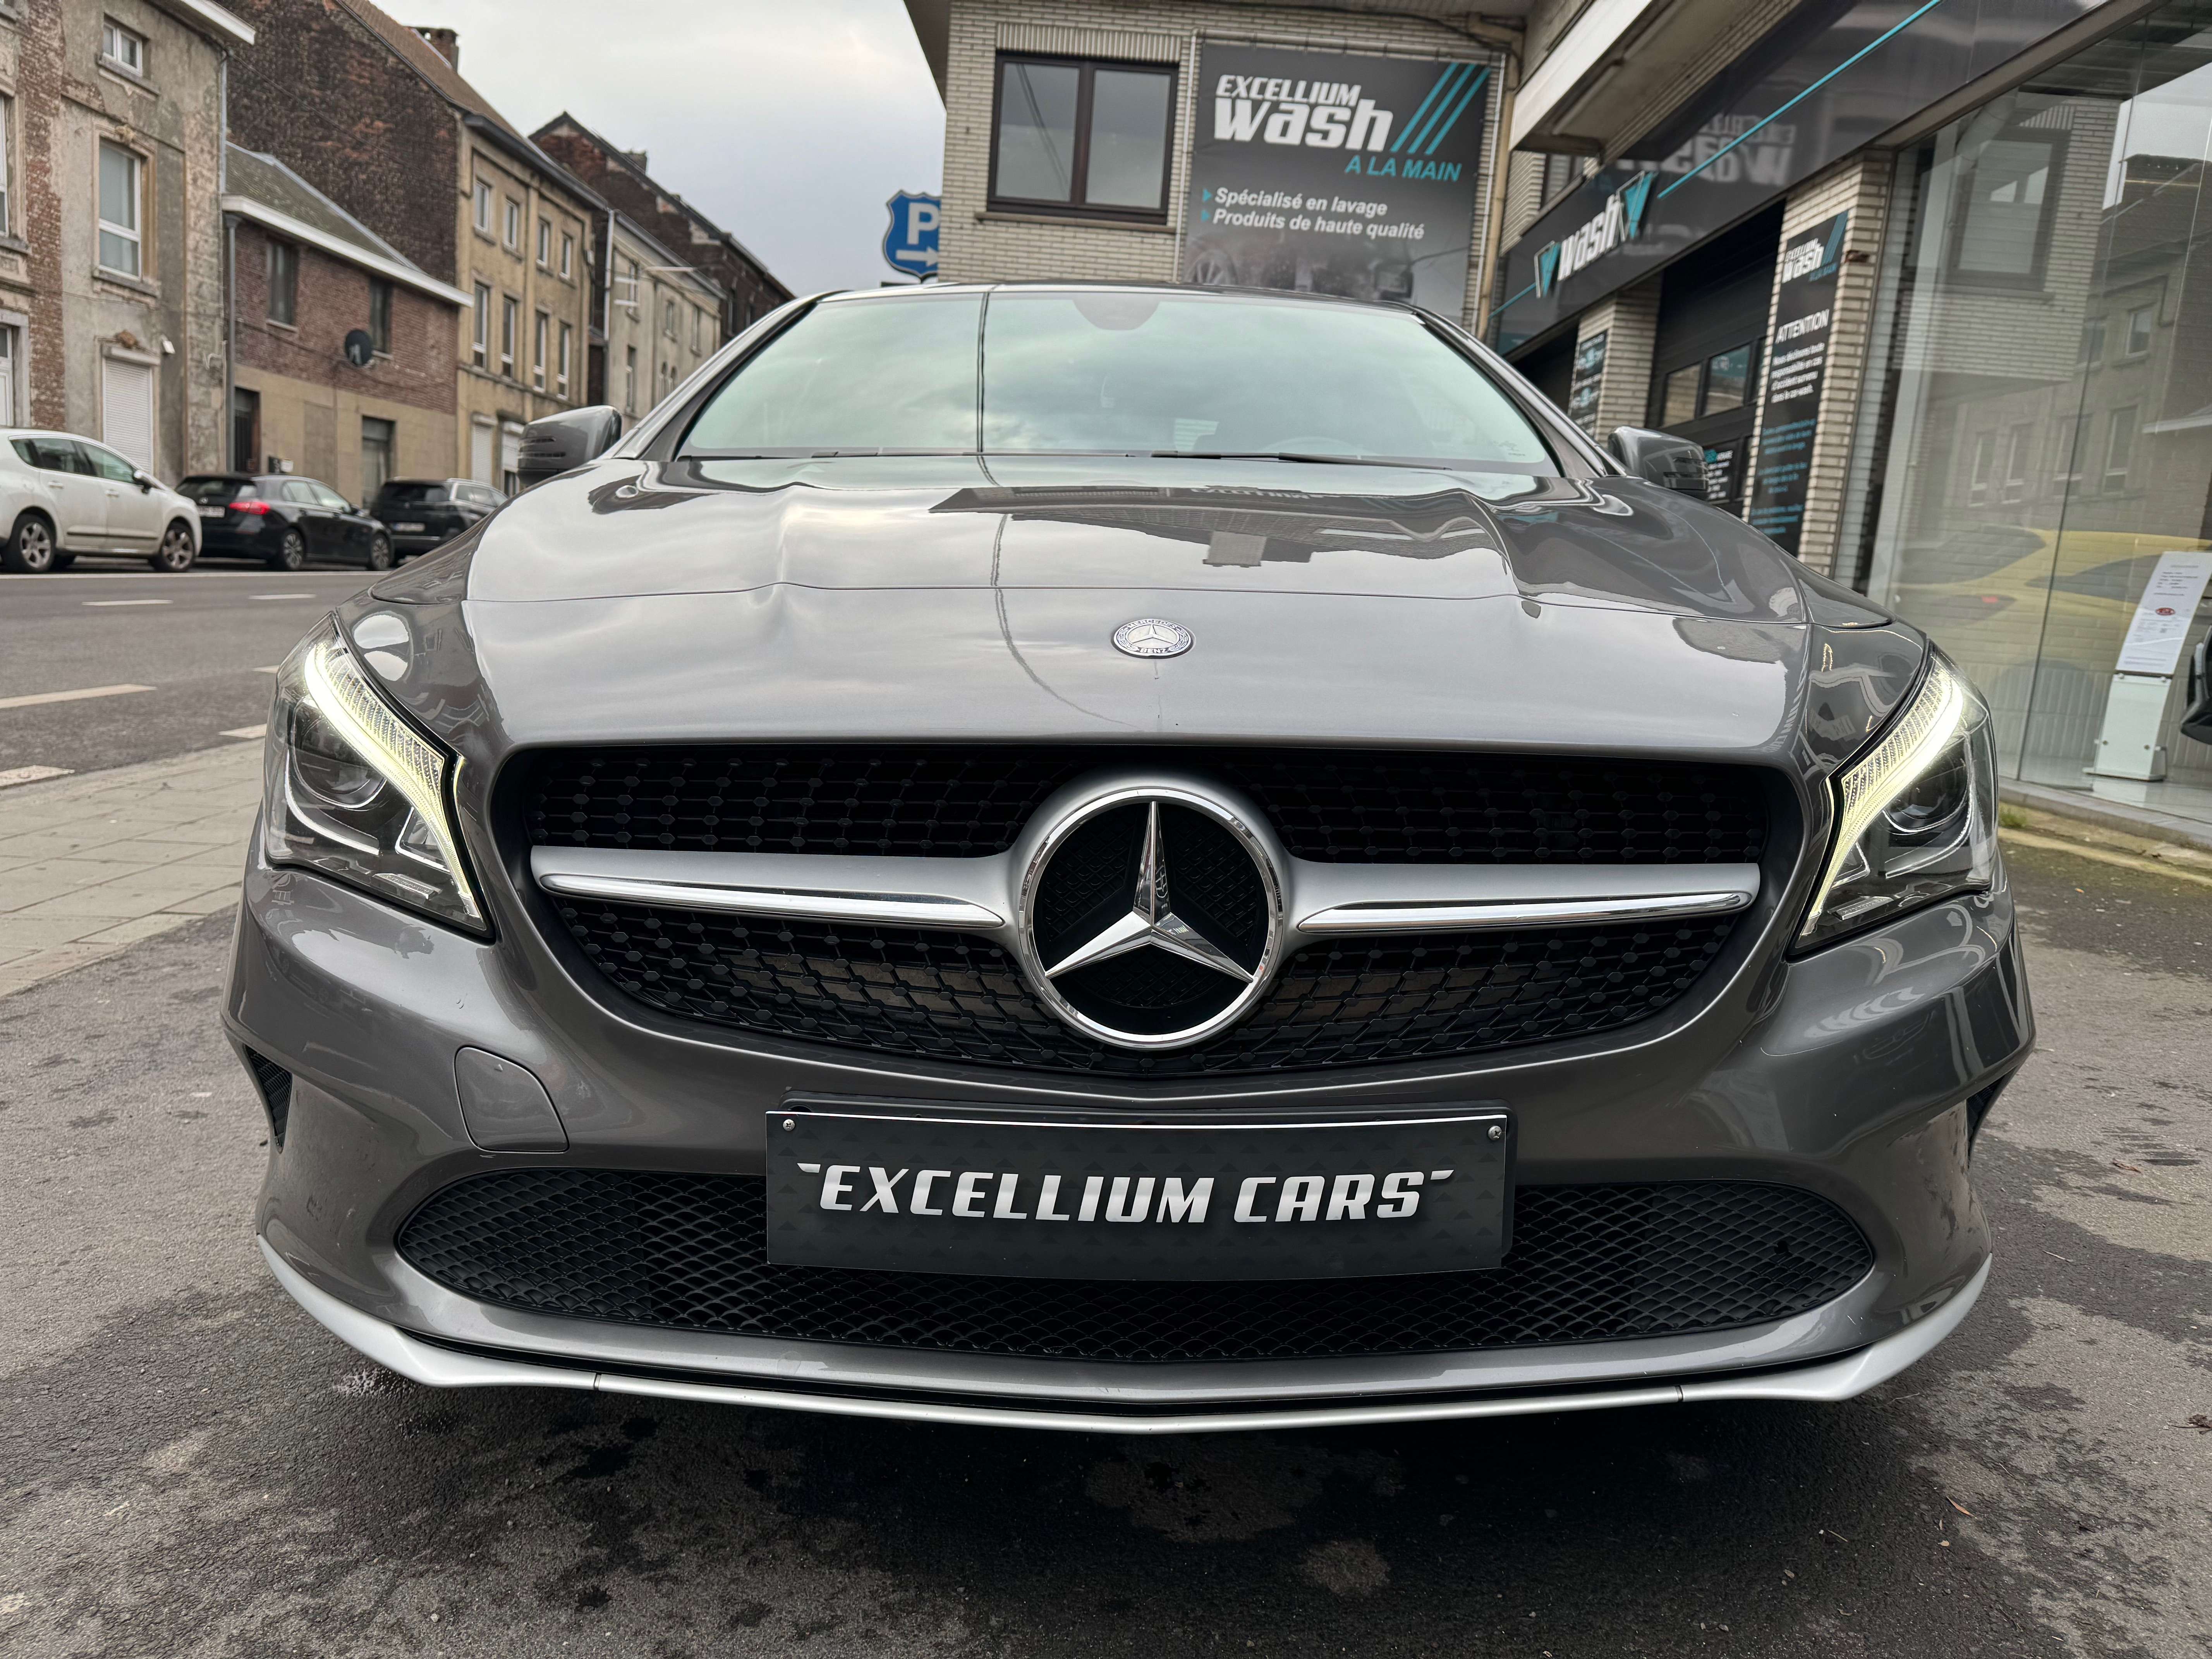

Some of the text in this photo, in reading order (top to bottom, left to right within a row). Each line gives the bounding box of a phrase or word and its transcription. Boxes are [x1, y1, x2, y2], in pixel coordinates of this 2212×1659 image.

[1215, 74, 1361, 107] EXCELLIUM
[1344, 156, 1462, 182] A LA MAIN
[1214, 187, 1388, 219] Spécialisé en lavage
[907, 202, 940, 245] P
[1212, 208, 1425, 240] Produits de haute qualité
[1775, 309, 1829, 344] ATTENTION
[819, 1164, 1425, 1223] EXCELLIUM CARS
